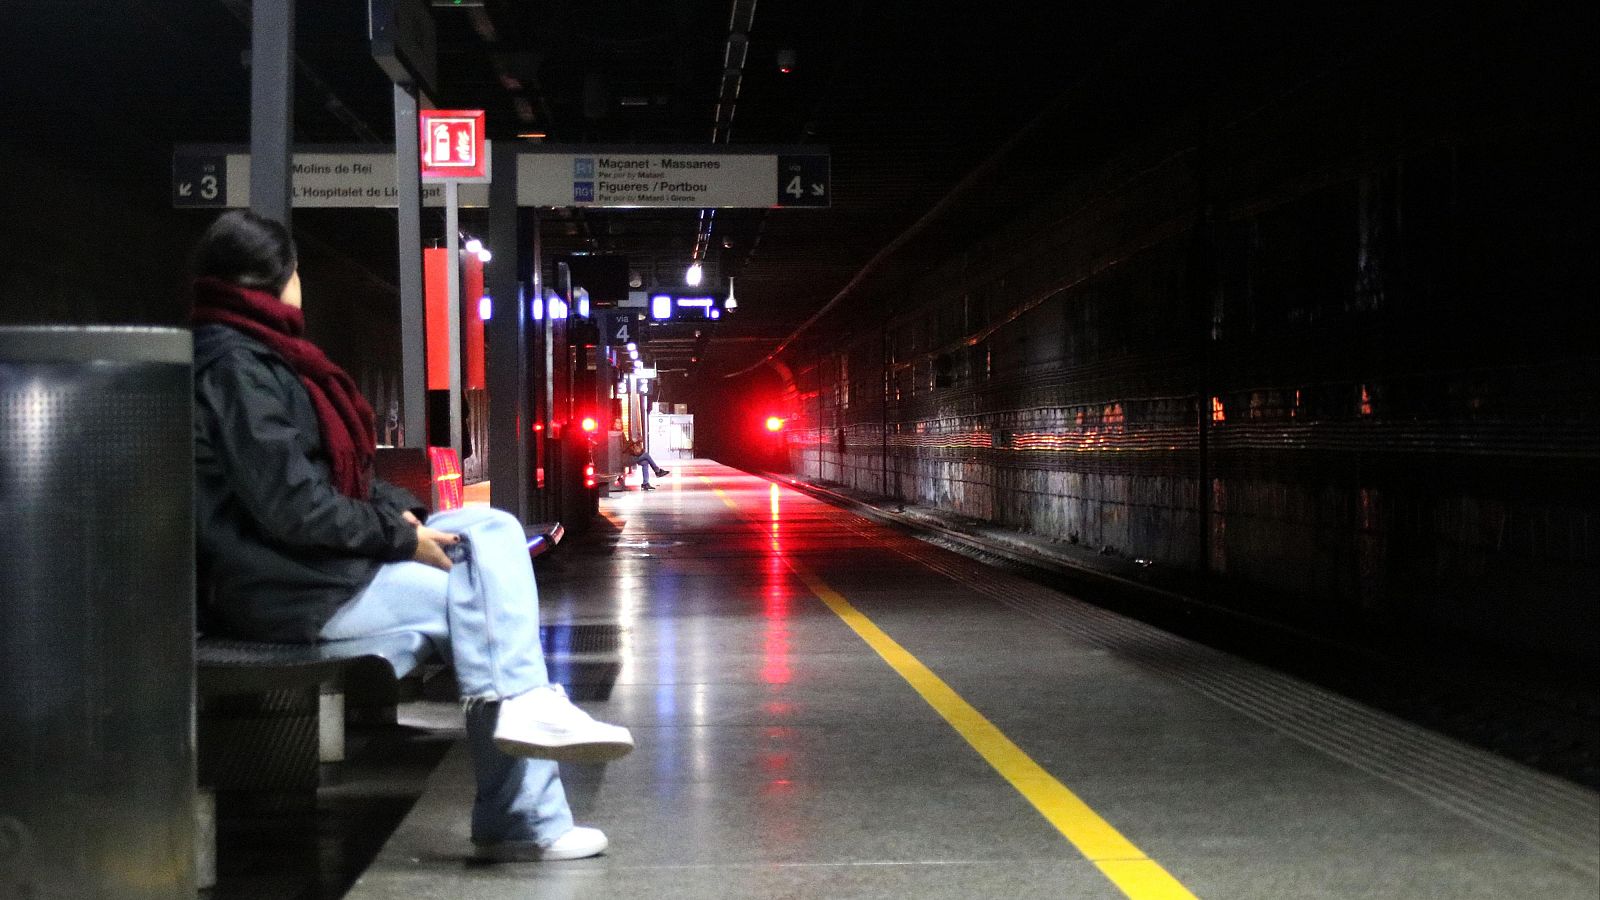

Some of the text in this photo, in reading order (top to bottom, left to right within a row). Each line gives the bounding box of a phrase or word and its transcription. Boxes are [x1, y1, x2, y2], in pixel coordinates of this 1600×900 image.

[291, 163, 372, 174] Molins de Rei
[598, 158, 649, 171] Maçanet
[661, 158, 721, 169] Massanes
[200, 174, 218, 200] 3
[366, 186, 381, 197] de
[384, 186, 440, 199] Llgat
[598, 181, 649, 193] Figueres
[660, 181, 707, 192] Portbou
[786, 175, 804, 199] 4
[616, 324, 630, 343] 4
